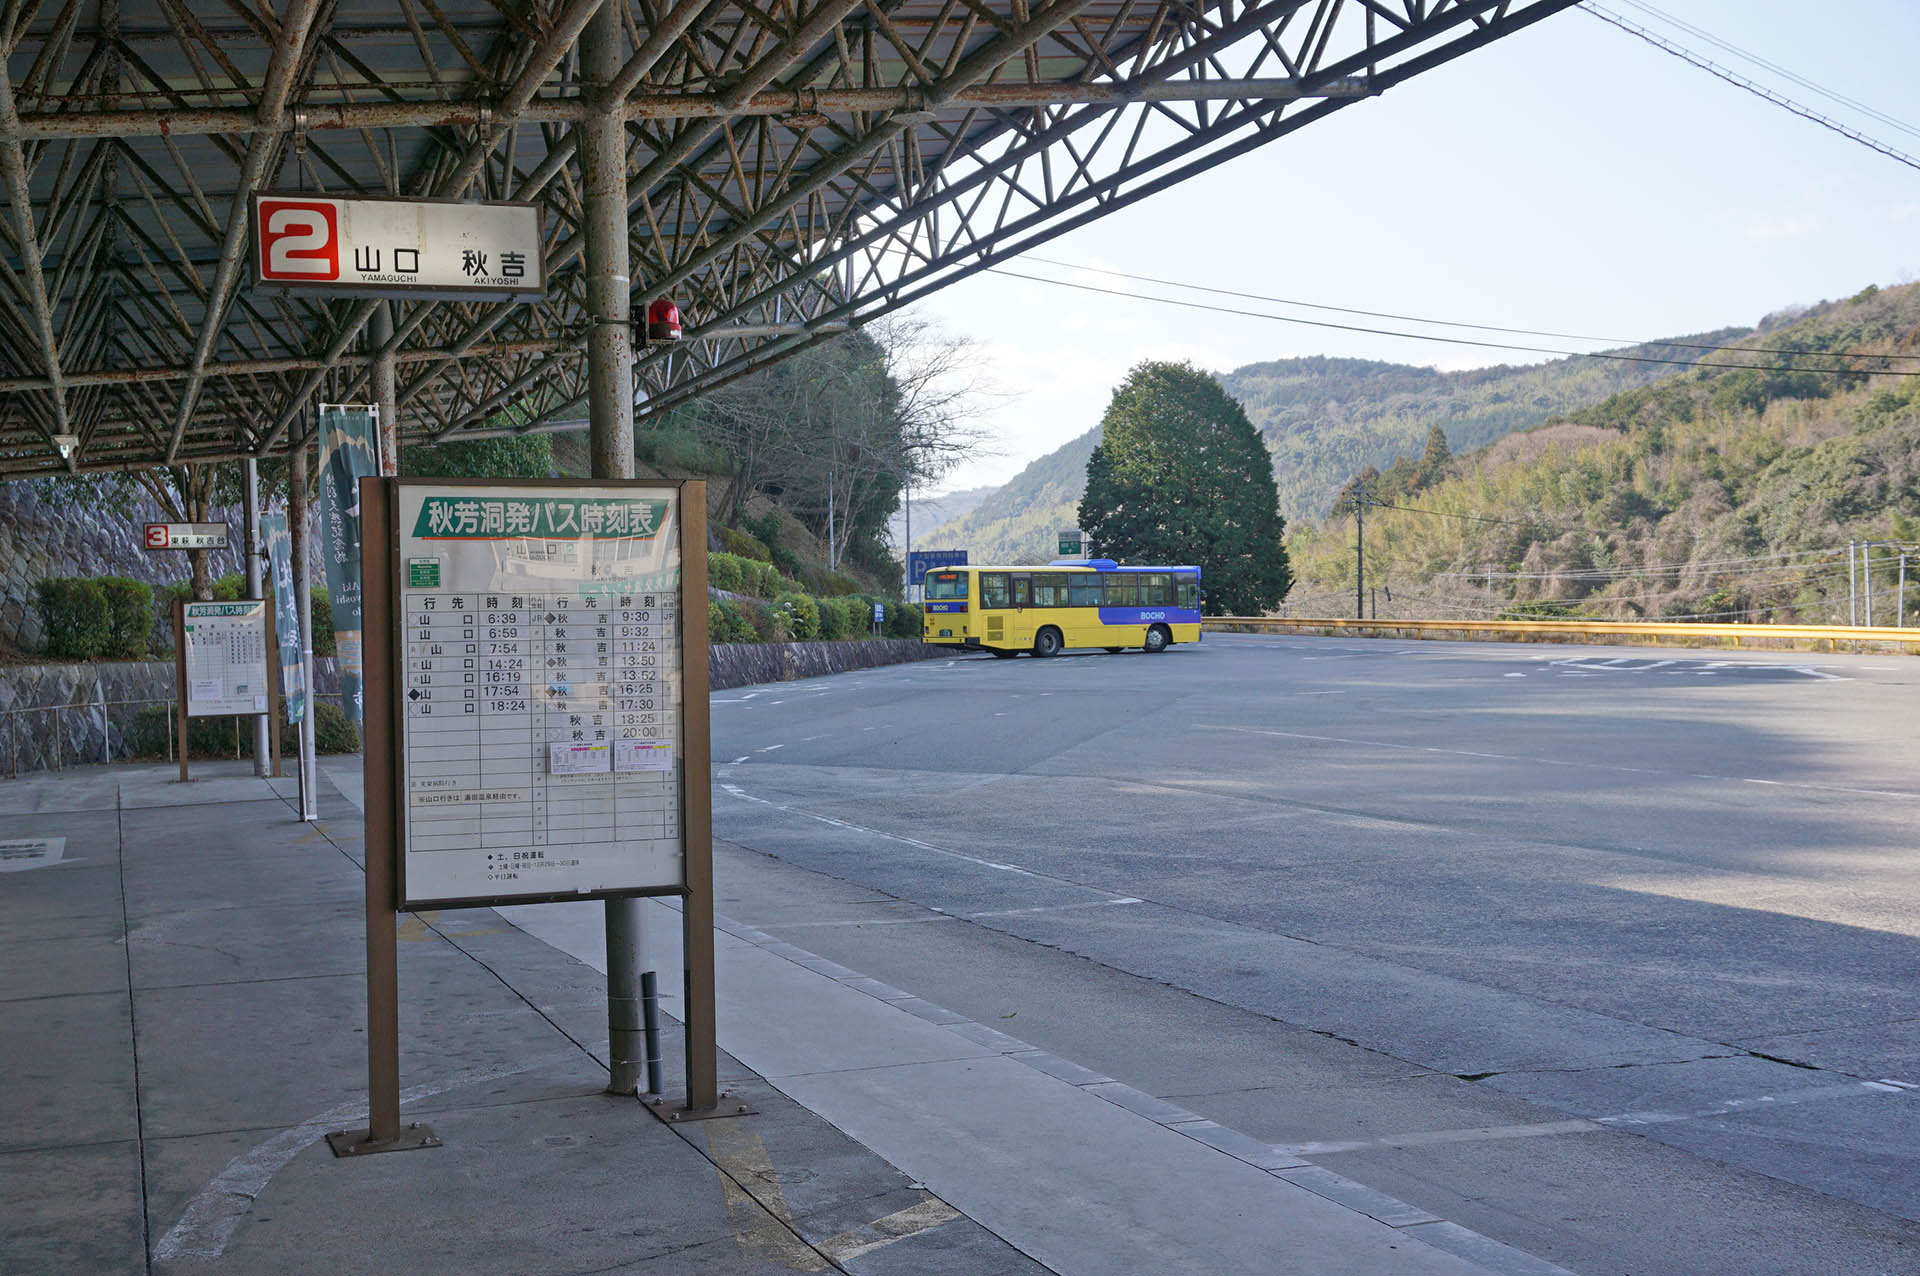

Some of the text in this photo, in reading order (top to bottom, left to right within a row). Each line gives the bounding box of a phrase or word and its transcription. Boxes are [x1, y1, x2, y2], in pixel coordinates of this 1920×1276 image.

[268, 209, 331, 274] 2
[355, 246, 525, 277] 山口 秋吉
[361, 274, 519, 285] YAMAGUCHI AKIYOSHI
[428, 501, 653, 534] 秋芳洞発バス時刻表
[149, 527, 166, 545] 3
[424, 597, 523, 610] 行先 時刻
[620, 596, 655, 608] 時刻
[488, 613, 516, 624] 6:39
[622, 611, 650, 622] 9:30
[1140, 611, 1166, 620] BOCHO
[489, 628, 517, 638] 6:59
[622, 626, 649, 637] 9:32
[490, 643, 518, 654] 7:54
[622, 641, 656, 652] 11:24
[489, 659, 523, 670] 14:24
[622, 656, 656, 666] 13:50
[486, 672, 521, 682] 16:19
[622, 670, 656, 681] 13:52
[484, 685, 519, 697] 17:54
[620, 683, 653, 695] 16:25
[490, 701, 526, 711] 18:24
[620, 699, 654, 710] 17:30
[622, 713, 655, 724] 18:25
[623, 727, 657, 738] 20:00
